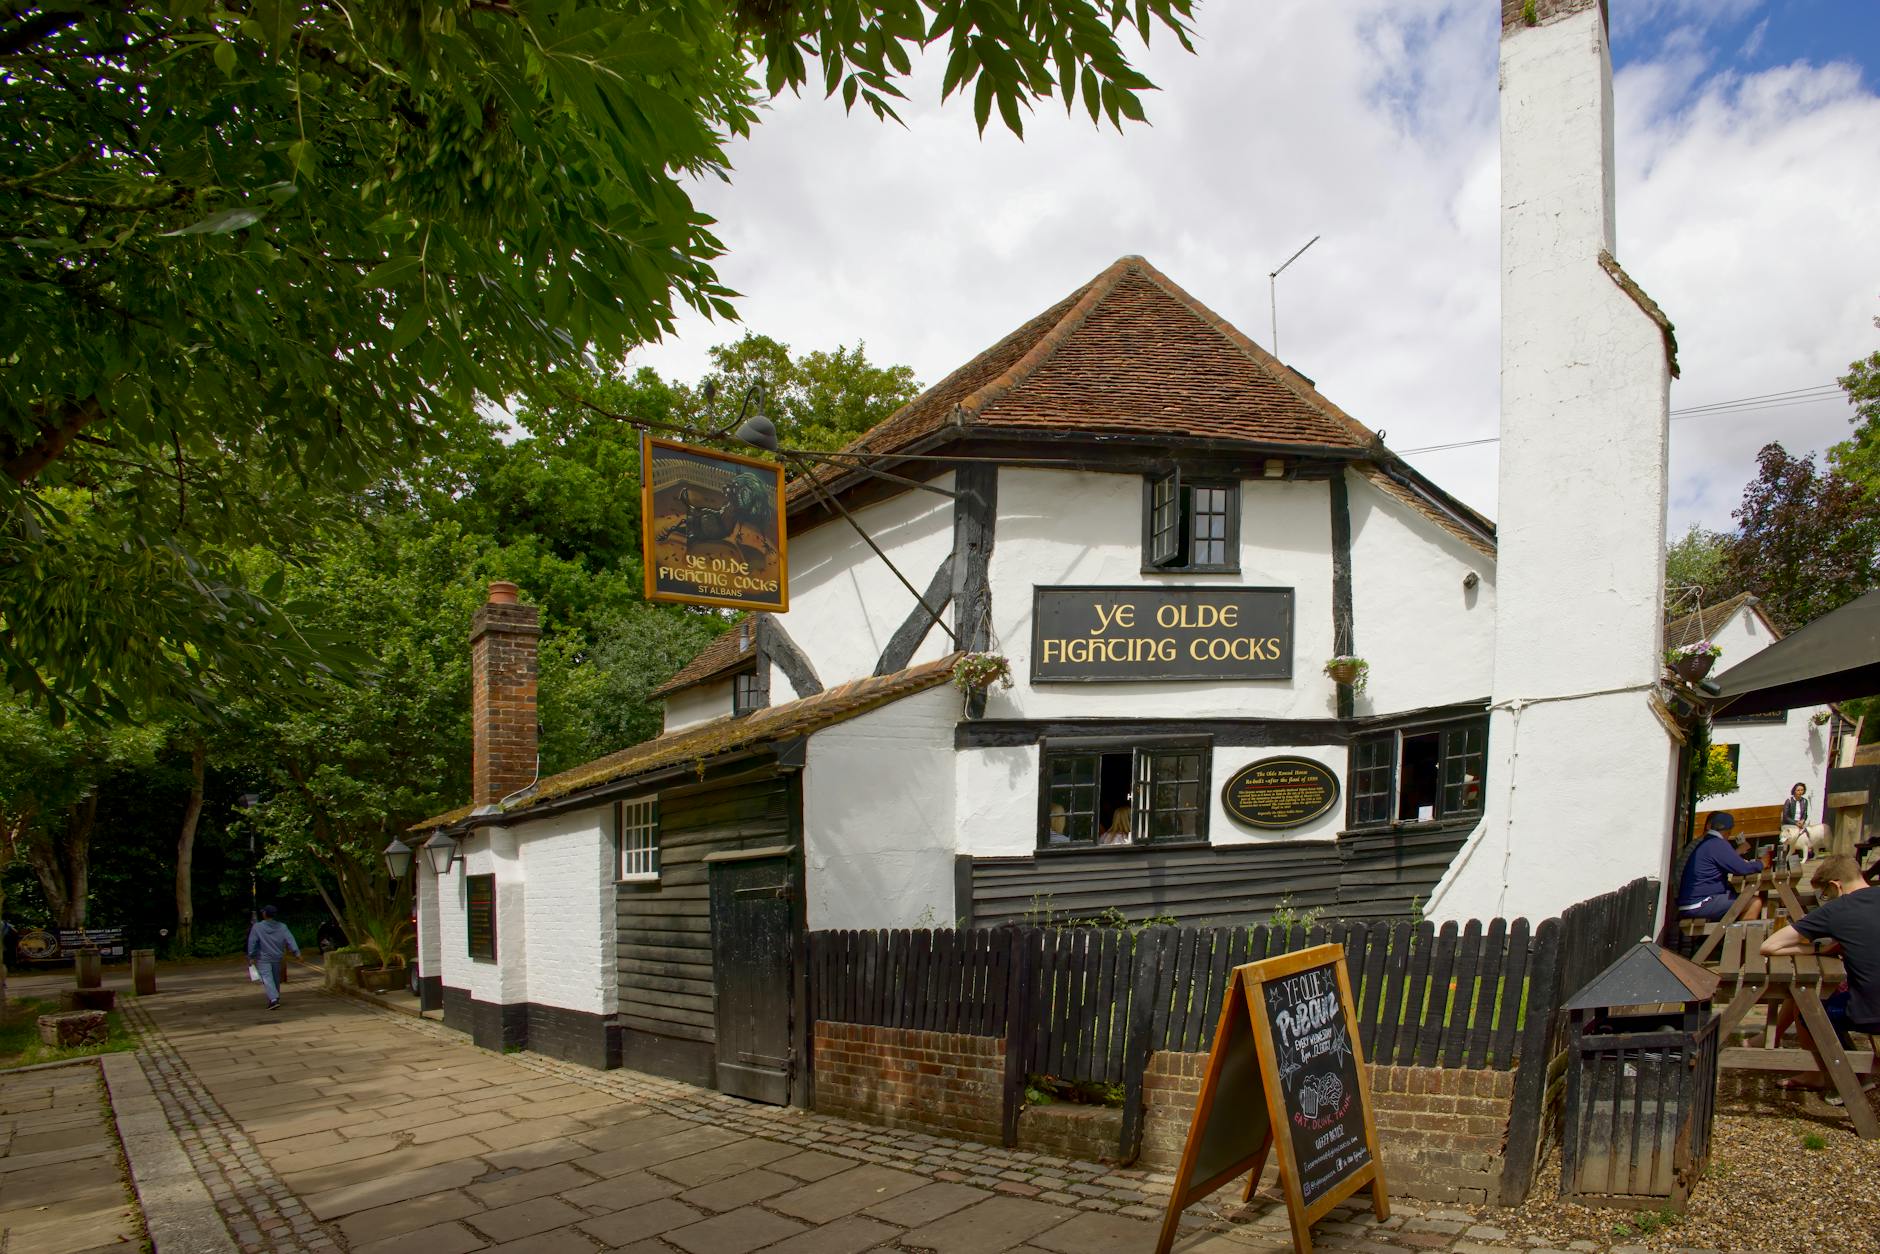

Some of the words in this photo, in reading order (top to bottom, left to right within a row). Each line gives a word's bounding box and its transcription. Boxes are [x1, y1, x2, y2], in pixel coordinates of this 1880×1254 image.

[686, 555, 706, 569] YE
[712, 559, 749, 575] OLDE
[659, 566, 728, 586] FIGHTING
[733, 576, 778, 592] COCKS
[710, 587, 743, 597] ALBANS
[1090, 604, 1135, 635] YE
[1156, 604, 1239, 628] OLDE
[1042, 637, 1177, 664] FIGHTING
[1189, 637, 1281, 661] COCKS
[1282, 978, 1301, 1007] YE
[1299, 970, 1323, 1001] OLDE
[1309, 991, 1339, 1030] QUIZ
